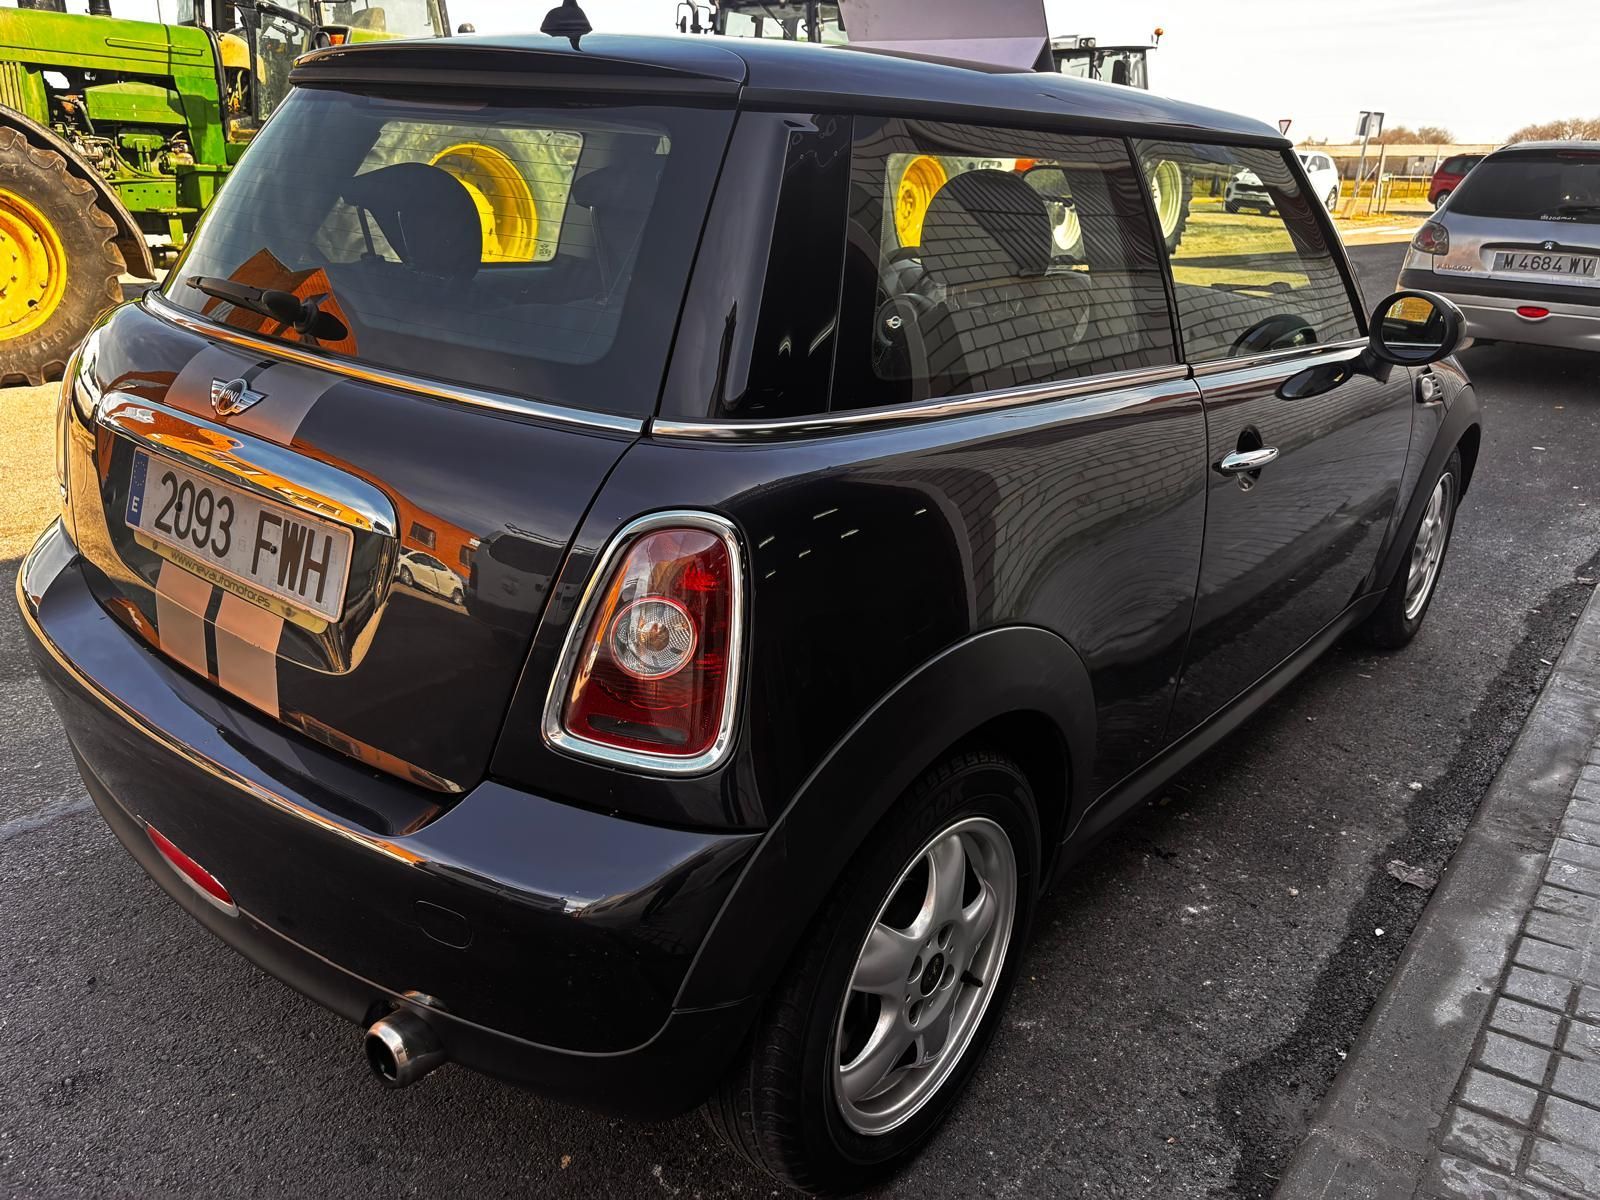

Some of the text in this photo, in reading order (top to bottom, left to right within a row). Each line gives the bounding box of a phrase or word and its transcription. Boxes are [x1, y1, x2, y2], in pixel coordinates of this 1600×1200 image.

[1503, 253, 1593, 274] M 4684 WV
[132, 495, 139, 513] E
[154, 471, 332, 603] 2093 FWH
